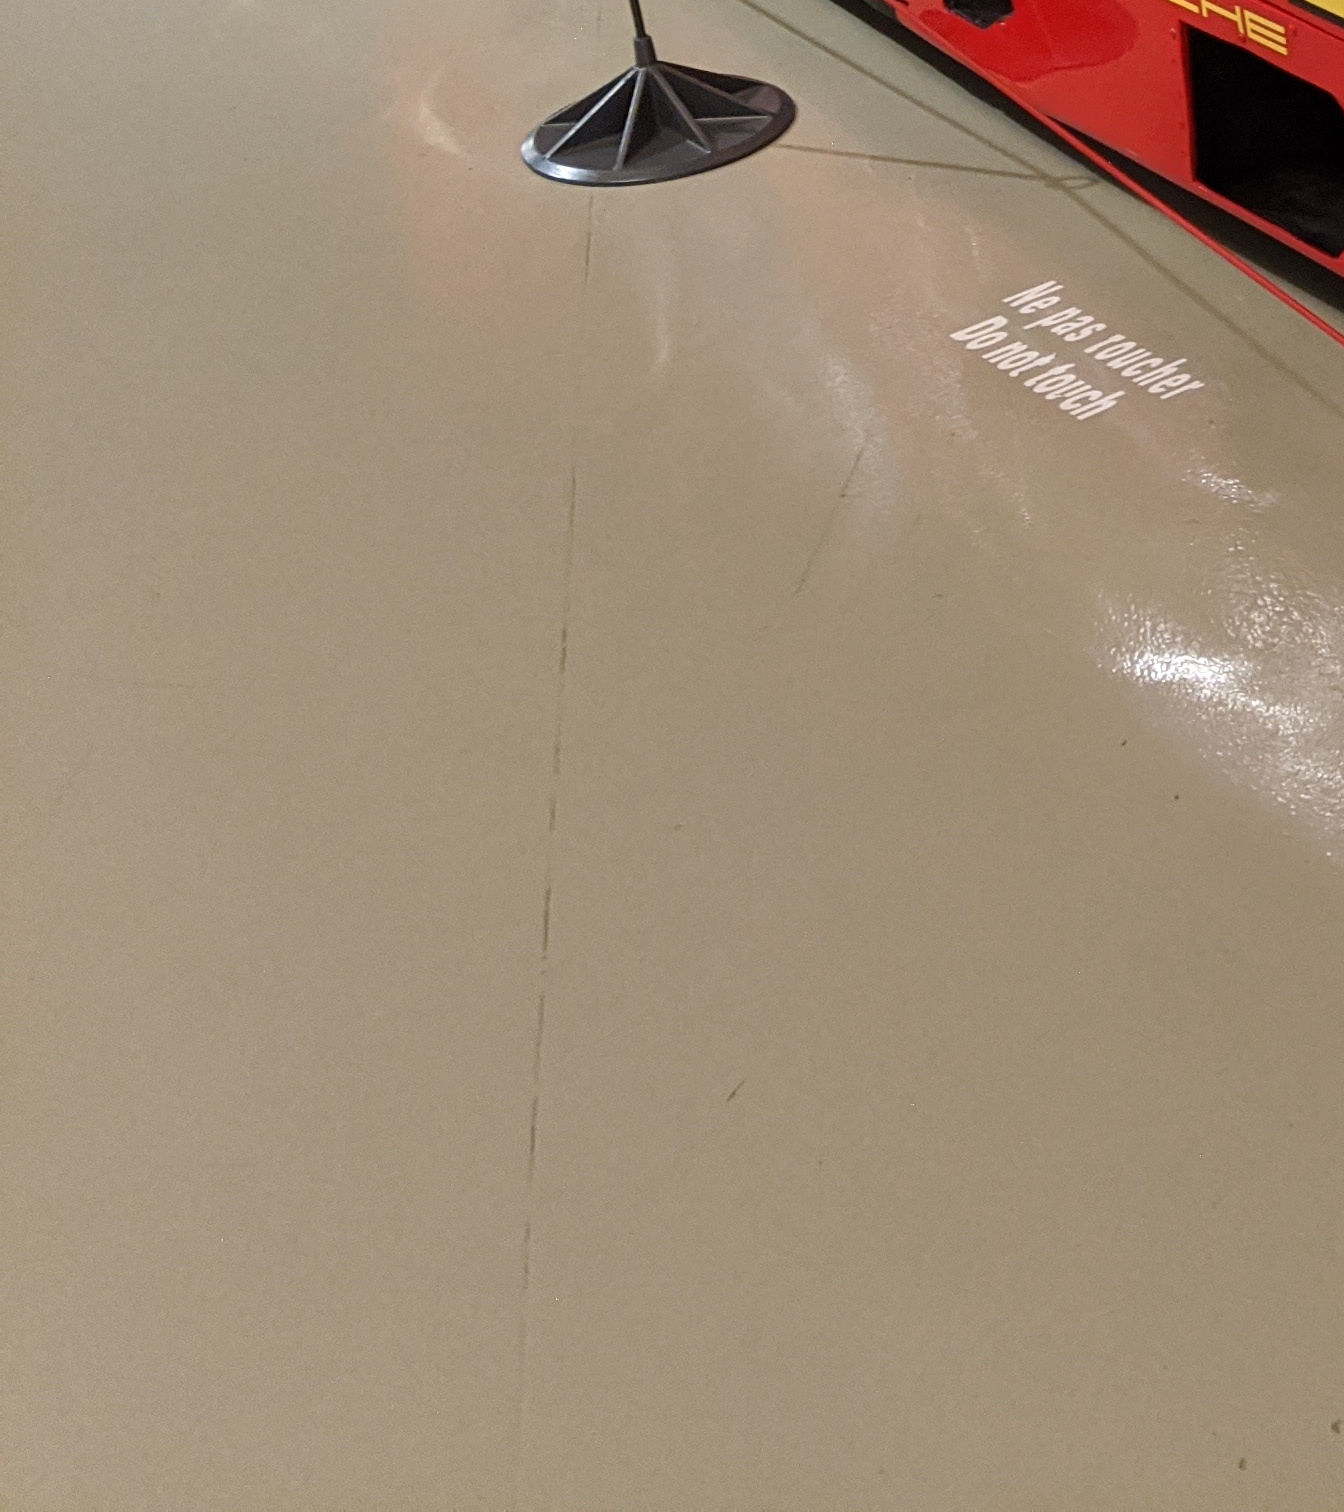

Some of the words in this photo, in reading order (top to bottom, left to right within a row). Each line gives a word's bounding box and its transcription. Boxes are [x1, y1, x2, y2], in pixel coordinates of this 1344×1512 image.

[1002, 280, 1064, 314] Ne
[1022, 306, 1107, 342] pas
[950, 315, 1008, 350] Do
[981, 340, 1057, 378] not
[1023, 363, 1125, 421] touch
